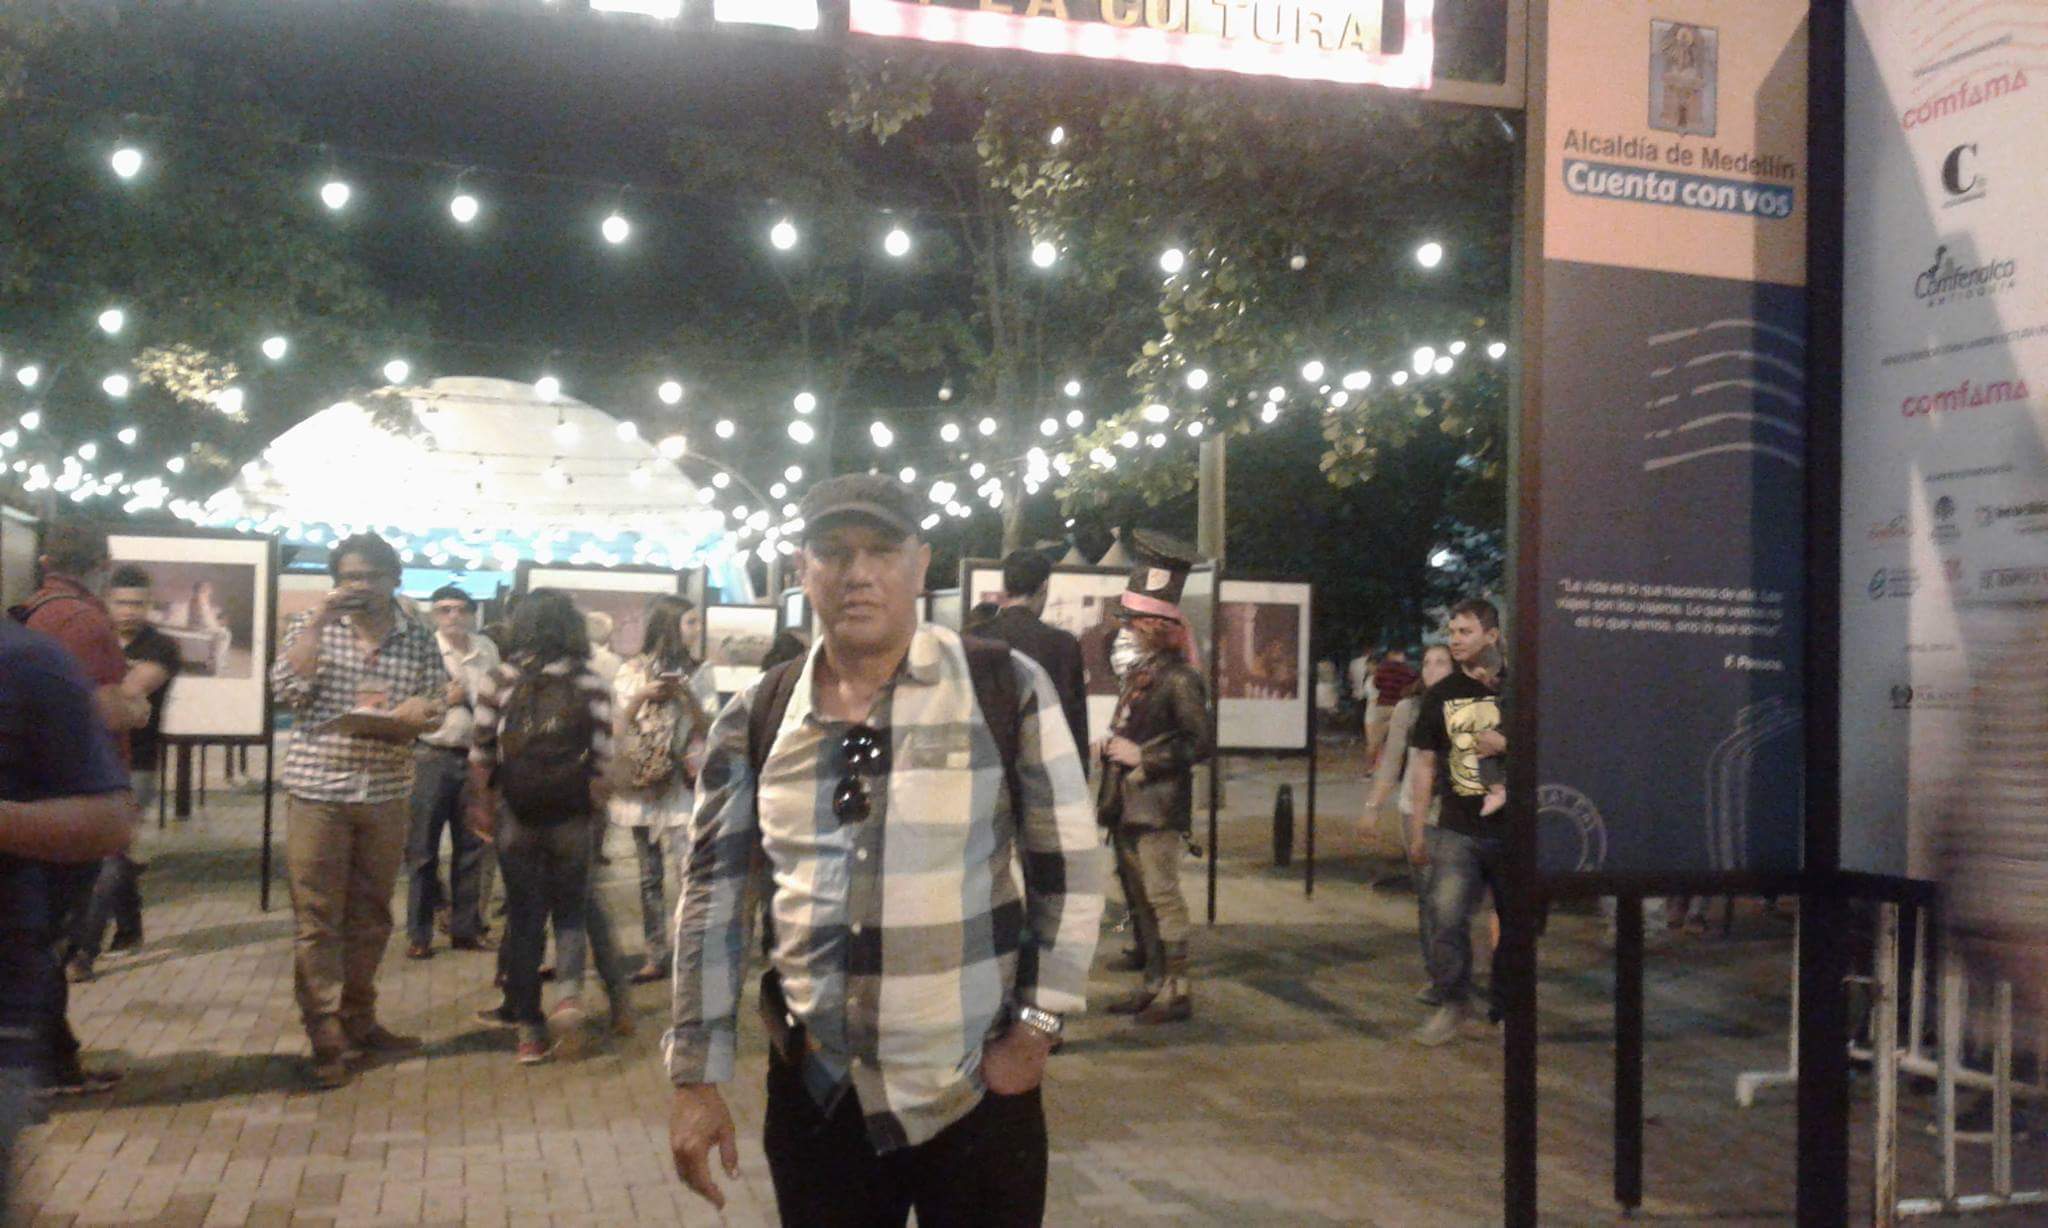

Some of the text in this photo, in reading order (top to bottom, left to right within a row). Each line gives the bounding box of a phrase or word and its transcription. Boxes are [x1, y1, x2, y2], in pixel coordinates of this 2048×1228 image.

[1902, 67, 2028, 131] comfama
[1564, 128, 1796, 179] Alcaldía de Medellín
[1566, 161, 1790, 217] Cuenta con vos
[1901, 377, 2028, 418] comfama
